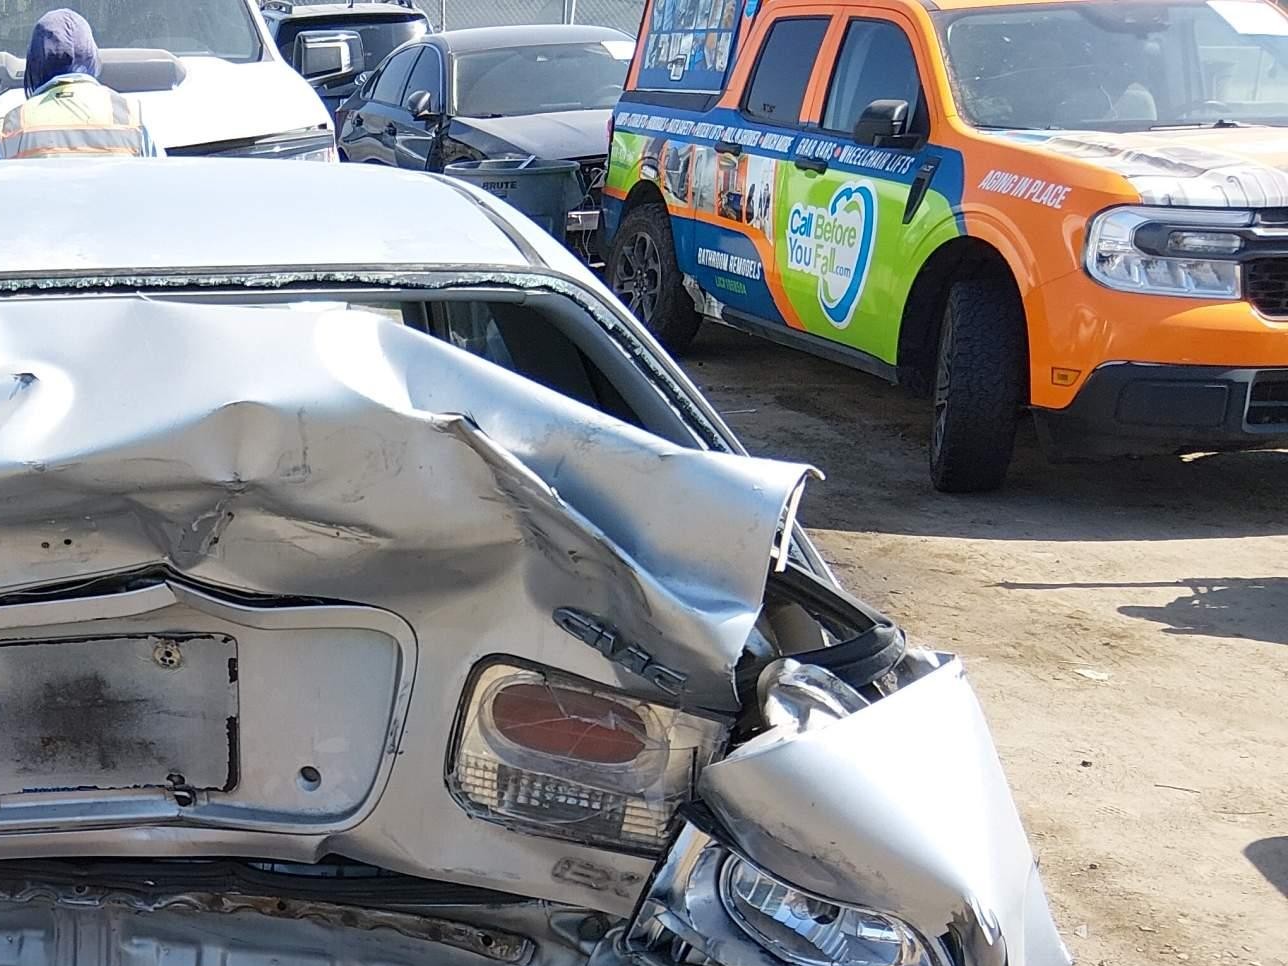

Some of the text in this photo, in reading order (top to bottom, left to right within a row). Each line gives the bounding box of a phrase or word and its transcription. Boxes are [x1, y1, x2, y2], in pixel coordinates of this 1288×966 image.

[838, 145, 890, 170] WHEELCHAIR
[885, 155, 915, 175] LIFTS
[481, 180, 518, 190] BRUTE
[978, 170, 1072, 209] AGING IN PLACE
[790, 208, 857, 248] Call Before
[697, 247, 761, 280] BATHROOM REMODELS
[789, 236, 812, 267] You
